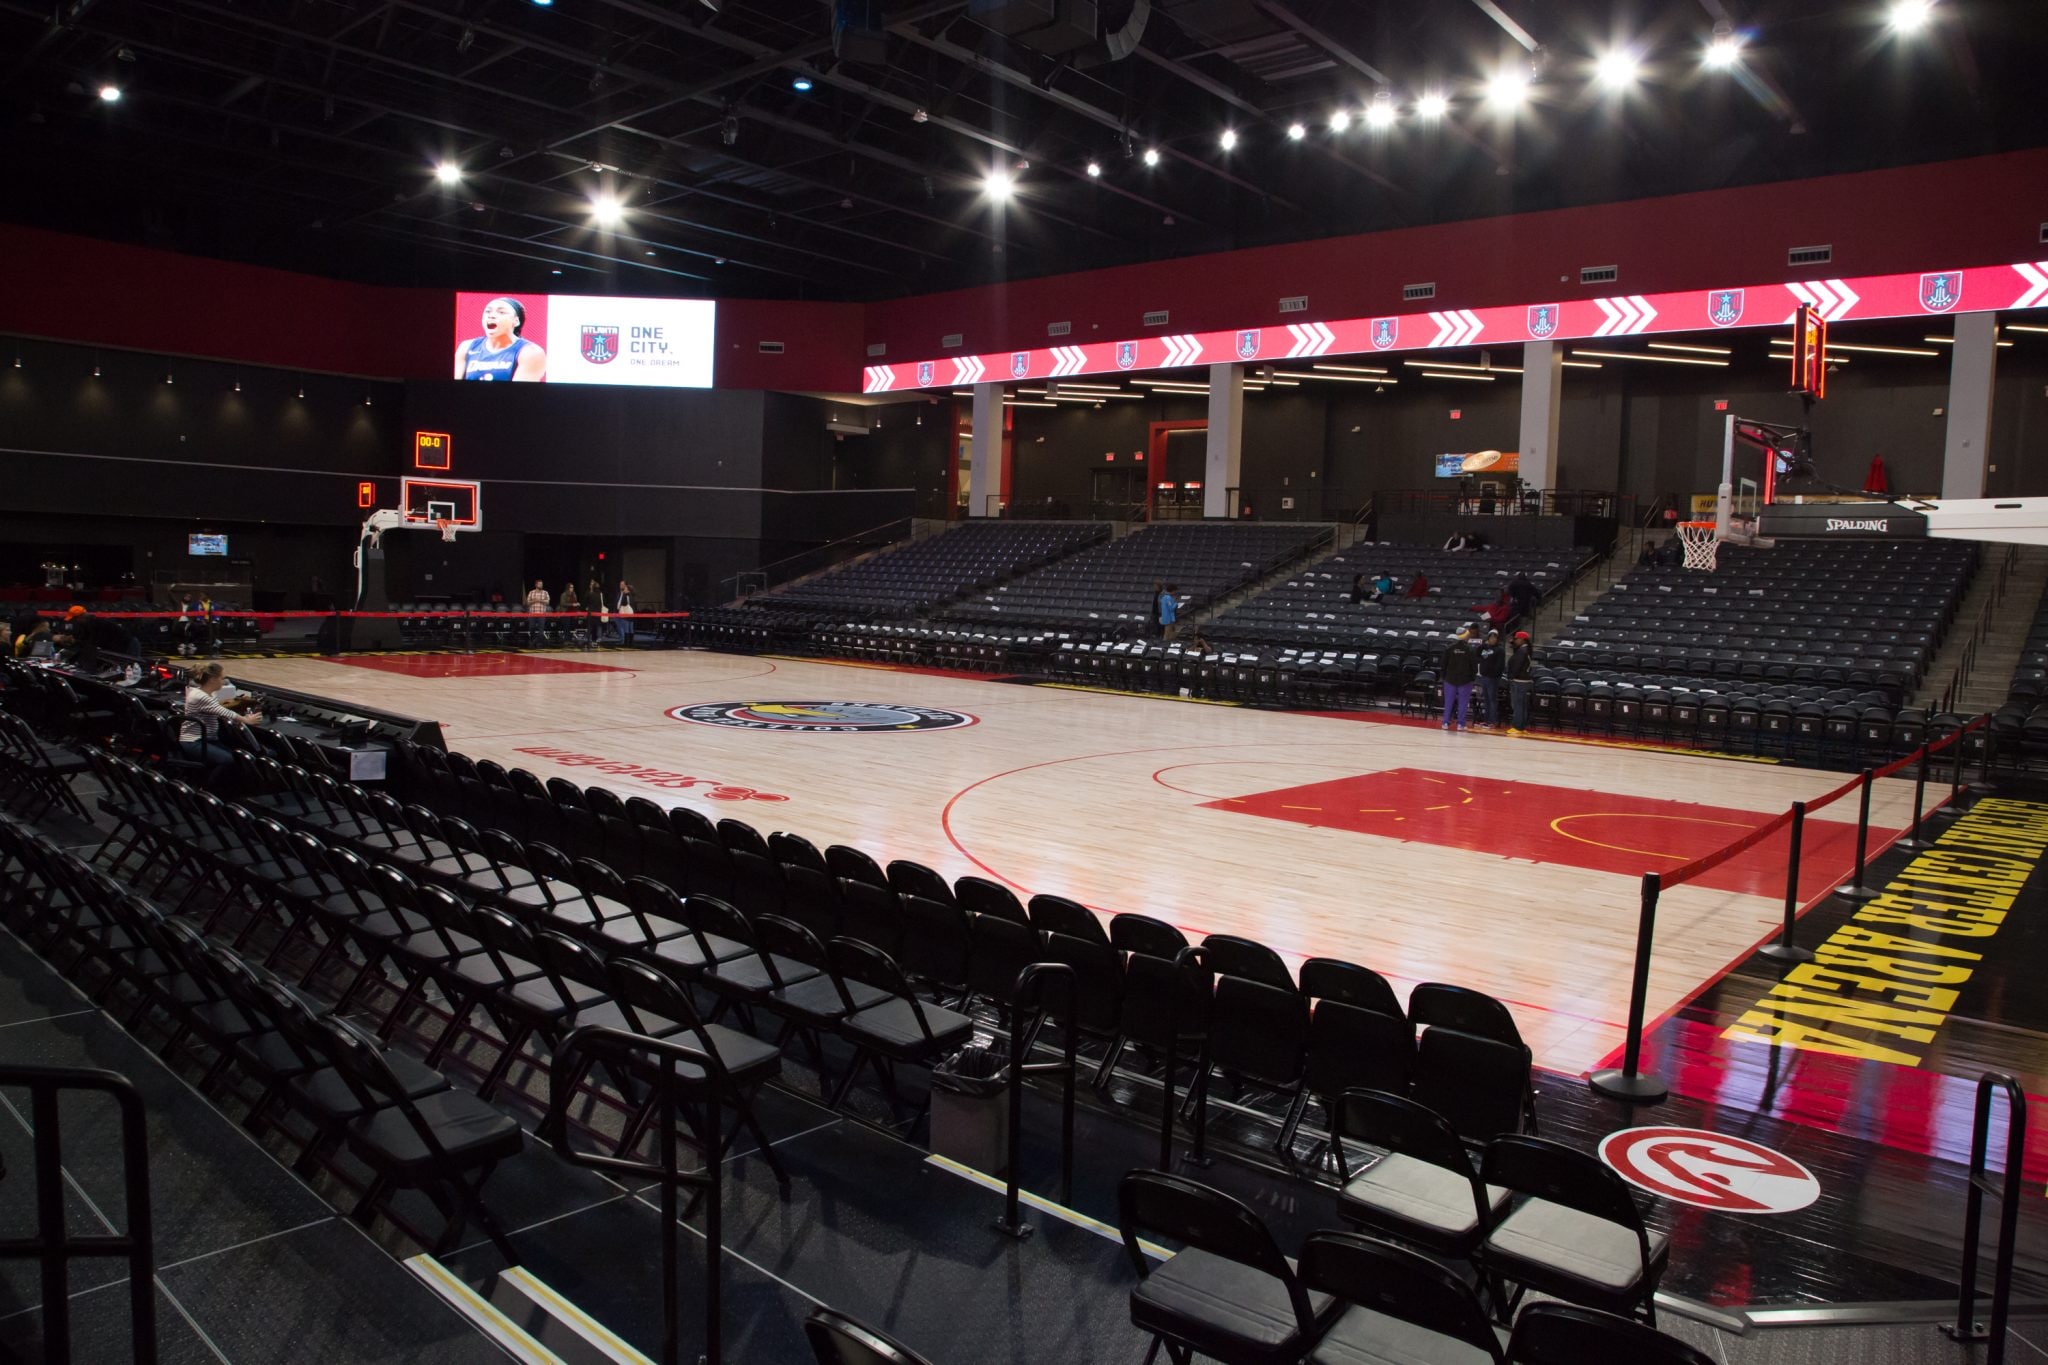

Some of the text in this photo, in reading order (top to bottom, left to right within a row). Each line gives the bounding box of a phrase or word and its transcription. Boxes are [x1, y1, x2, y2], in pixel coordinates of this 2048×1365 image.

[631, 326, 664, 339] ONE
[630, 358, 680, 367] ONE DREAM
[1826, 518, 1888, 532] SPALDING
[1852, 850, 2036, 937] CENTER
[1719, 924, 1984, 1067] ARENA
